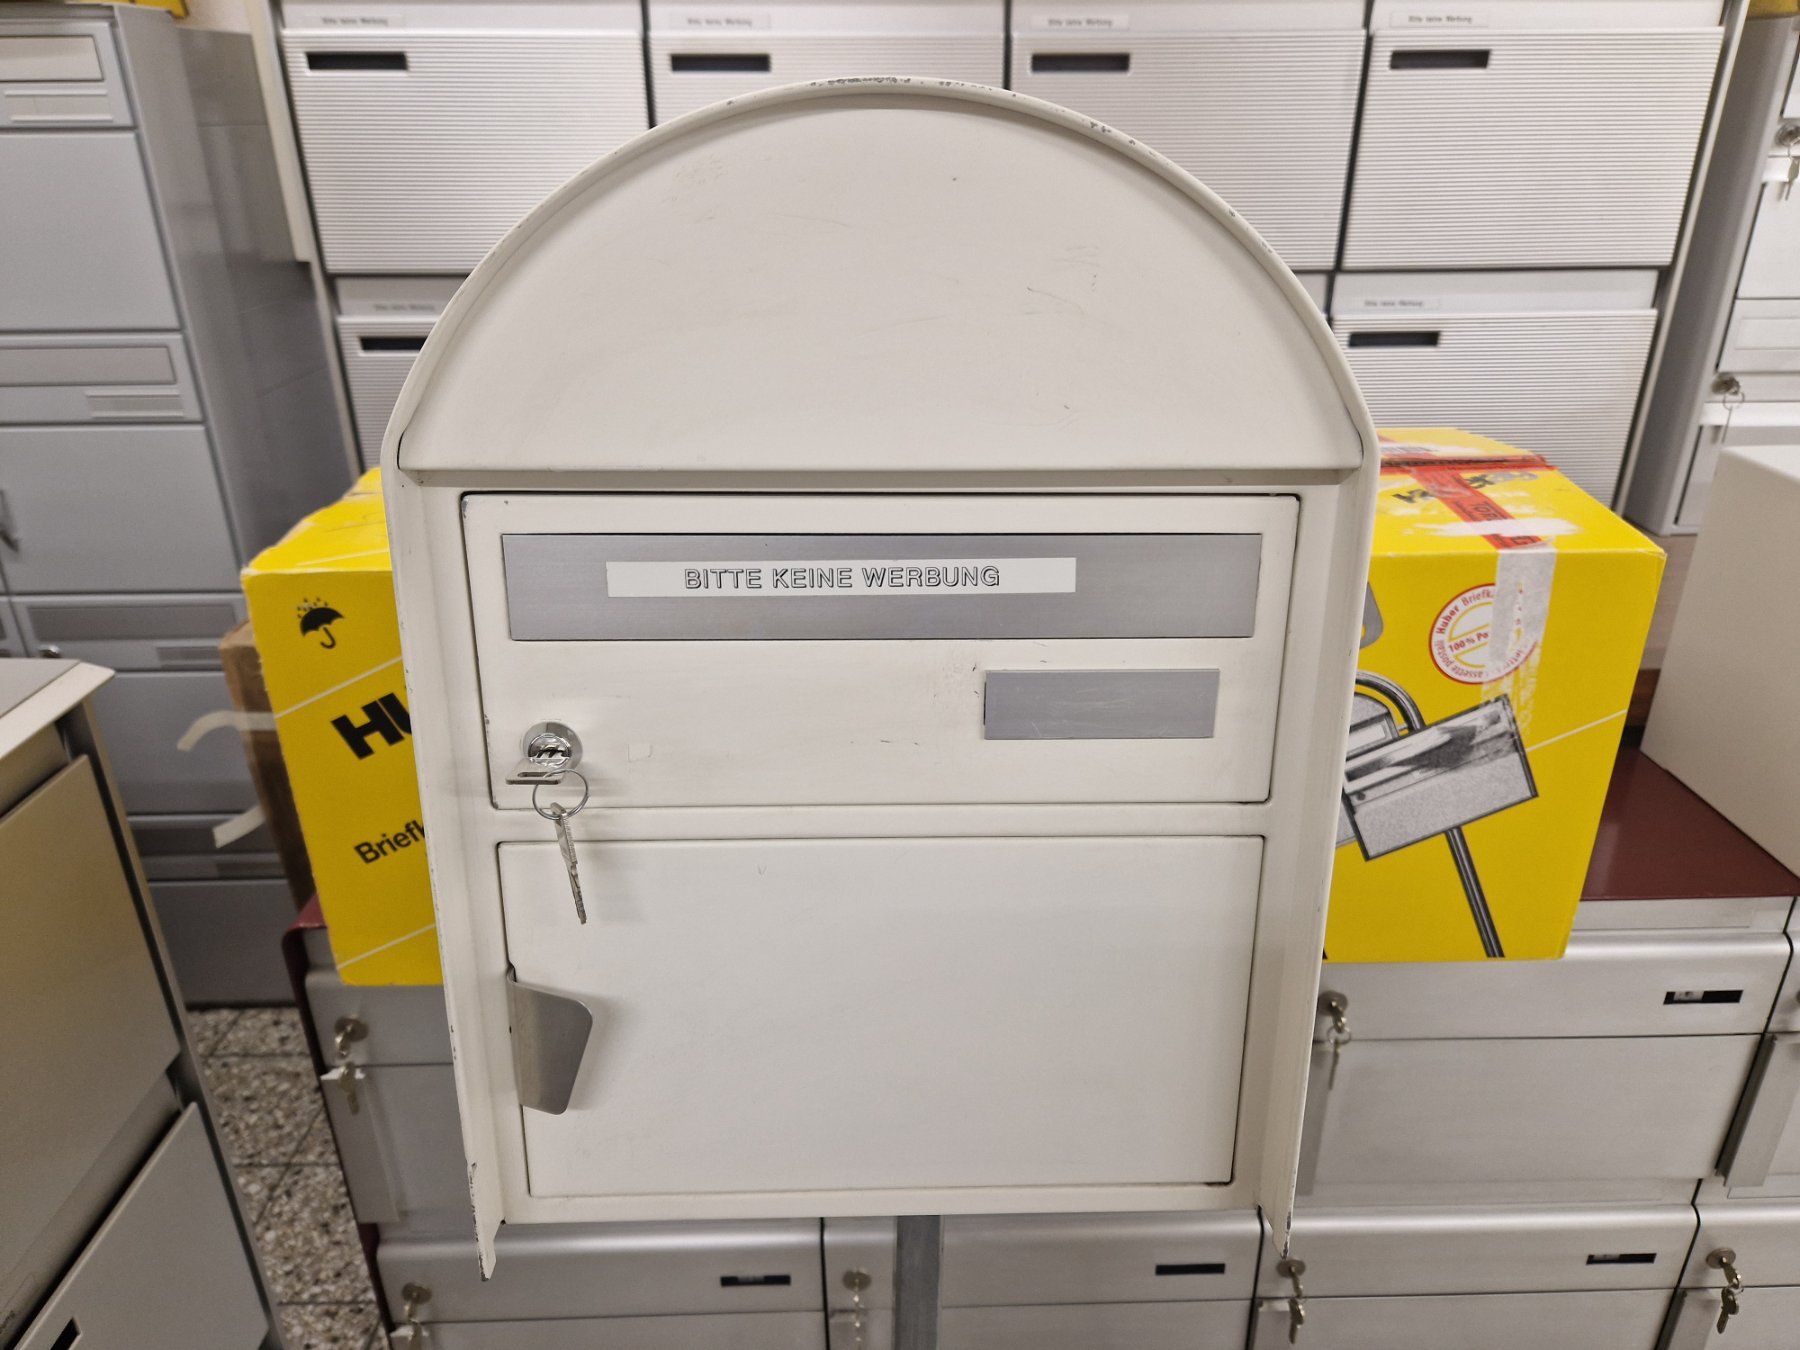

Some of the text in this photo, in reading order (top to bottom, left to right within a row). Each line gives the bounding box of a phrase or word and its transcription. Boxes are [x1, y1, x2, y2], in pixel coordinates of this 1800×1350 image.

[684, 565, 1000, 589] BITTE KEINE WERBUNG
[1436, 604, 1460, 635] Huber
